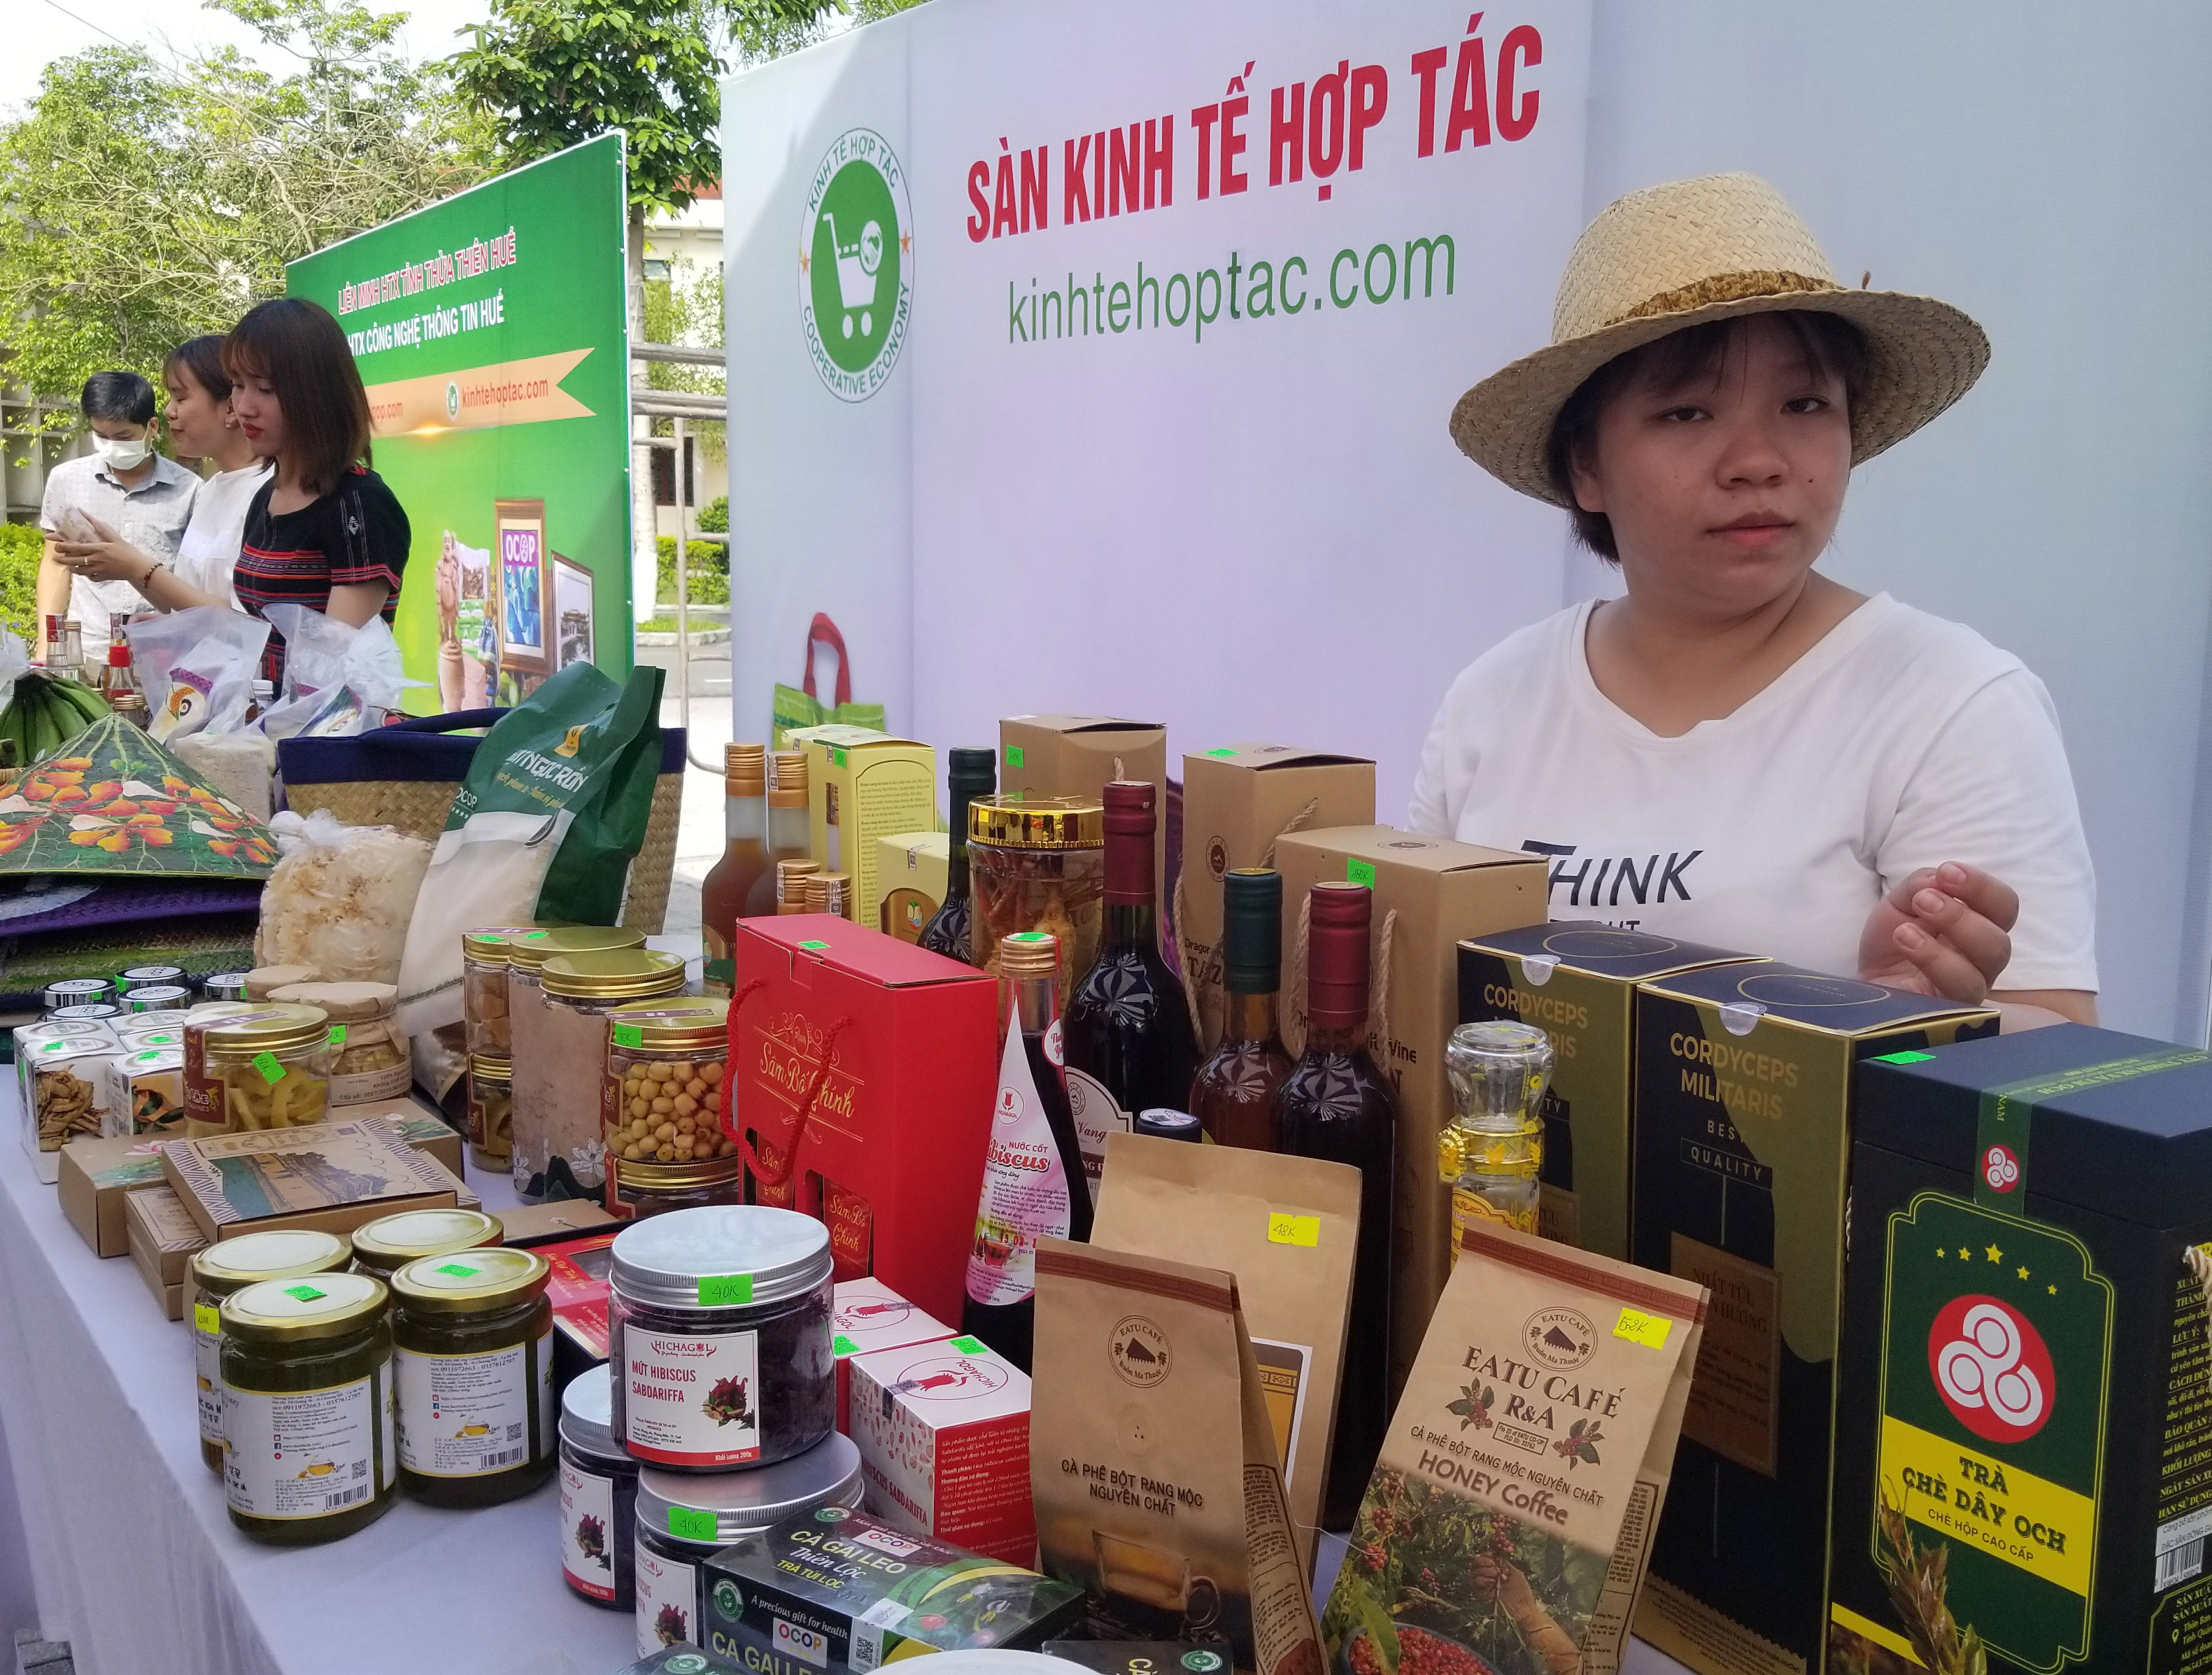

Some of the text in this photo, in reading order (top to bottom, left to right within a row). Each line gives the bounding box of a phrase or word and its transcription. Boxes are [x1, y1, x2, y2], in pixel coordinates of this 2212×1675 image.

[967, 11, 1543, 243] SÀN KINH TẾ HỢP TÁC
[808, 160, 832, 213] KINH
[850, 135, 876, 162] HỢP
[879, 143, 899, 188] TÁC
[381, 269, 401, 304] HTX
[455, 236, 489, 279] THIÊN
[490, 225, 517, 271] HUẾ
[1009, 234, 1455, 344] kinhtehoptac.com
[366, 321, 392, 354] CÔNG
[393, 312, 421, 349] NGHỆ
[421, 304, 458, 339] THÔNG
[460, 301, 479, 330] TIN
[479, 288, 504, 327] HUẾ
[804, 285, 910, 395] COOPERATIVE ECONOMY
[462, 378, 549, 409] kinhtehoptac.com
[1483, 982, 1589, 1030] CORDYCEPS
[760, 1041, 787, 1083] Sâm
[1670, 1032, 1799, 1089] CORDYCEPS
[1680, 1068, 1783, 1120] MILITARIS
[1008, 1140, 1049, 1153] NƯỚC CỐT
[1077, 1121, 1107, 1143] Vang
[1707, 1119, 1747, 1145] BEST
[1690, 1145, 1763, 1182] QUALITY
[1272, 1222, 1297, 1237] 48K
[711, 1284, 739, 1301] 40K
[1119, 1324, 1164, 1345] EATU CAFÉ
[1541, 1314, 1591, 1338] EATU CAFÉ
[654, 1340, 713, 1352] HICHAGOL
[1547, 1354, 1558, 1364] Ma
[632, 1359, 697, 1383] MỨT HIBISCUS
[956, 1358, 1000, 1389] HICHAGOL
[1133, 1370, 1144, 1380] Ma
[1461, 1345, 1627, 1420] EATU CAFÉ
[632, 1381, 685, 1403] SABDARIFFA
[1502, 1392, 1555, 1431] R&A
[1426, 1432, 1448, 1448] PHÊ
[1448, 1439, 1471, 1457] BỘT
[1471, 1449, 1501, 1469] RANG
[1502, 1460, 1526, 1479] MỘC
[1526, 1469, 1571, 1494] NGUYÊN
[1959, 1455, 2010, 1497] TRÀ
[1061, 1457, 1204, 1508] CÀ PHÊ BỘT RANG MỘC
[1417, 1448, 1569, 1526] HONEY Coffee
[1089, 1483, 1176, 1517] NGUYÊN CHẤT
[1901, 1466, 2067, 1555] CHÈ DÂY OCH
[680, 1519, 702, 1534] 40K
[868, 1532, 914, 1550] OCOP
[1927, 1507, 2034, 1562] CHÈ HỘP CAO CẤP
[789, 1546, 836, 1569] Thiên
[821, 1540, 861, 1562] GAI
[857, 1550, 907, 1574] LEO
[777, 1559, 846, 1590] TRÀ TÚI LỌC
[751, 1595, 849, 1640] A precious gift for health
[779, 1623, 823, 1651] OCOP
